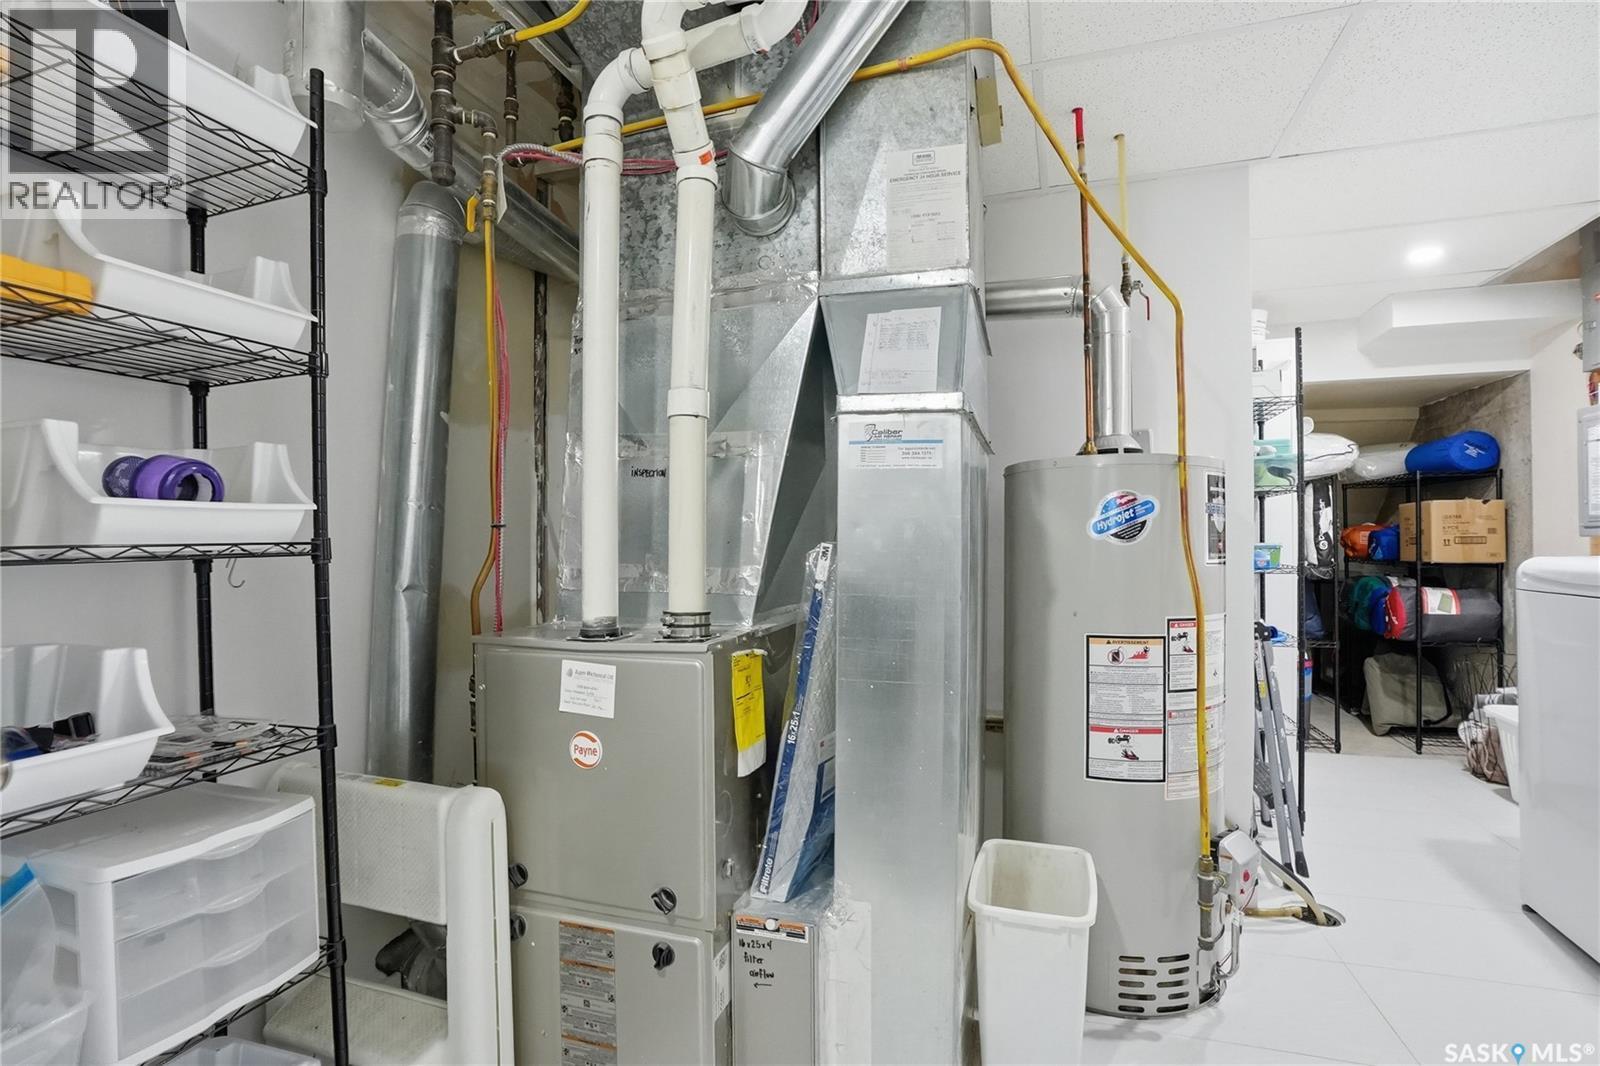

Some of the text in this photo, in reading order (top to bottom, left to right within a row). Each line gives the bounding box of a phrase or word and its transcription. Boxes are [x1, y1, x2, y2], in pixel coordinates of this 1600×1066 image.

[1096, 508, 1135, 531] Hydrojet
[820, 546, 830, 561] 3M
[573, 744, 598, 757] Payne
[759, 857, 774, 895] Filtrete
